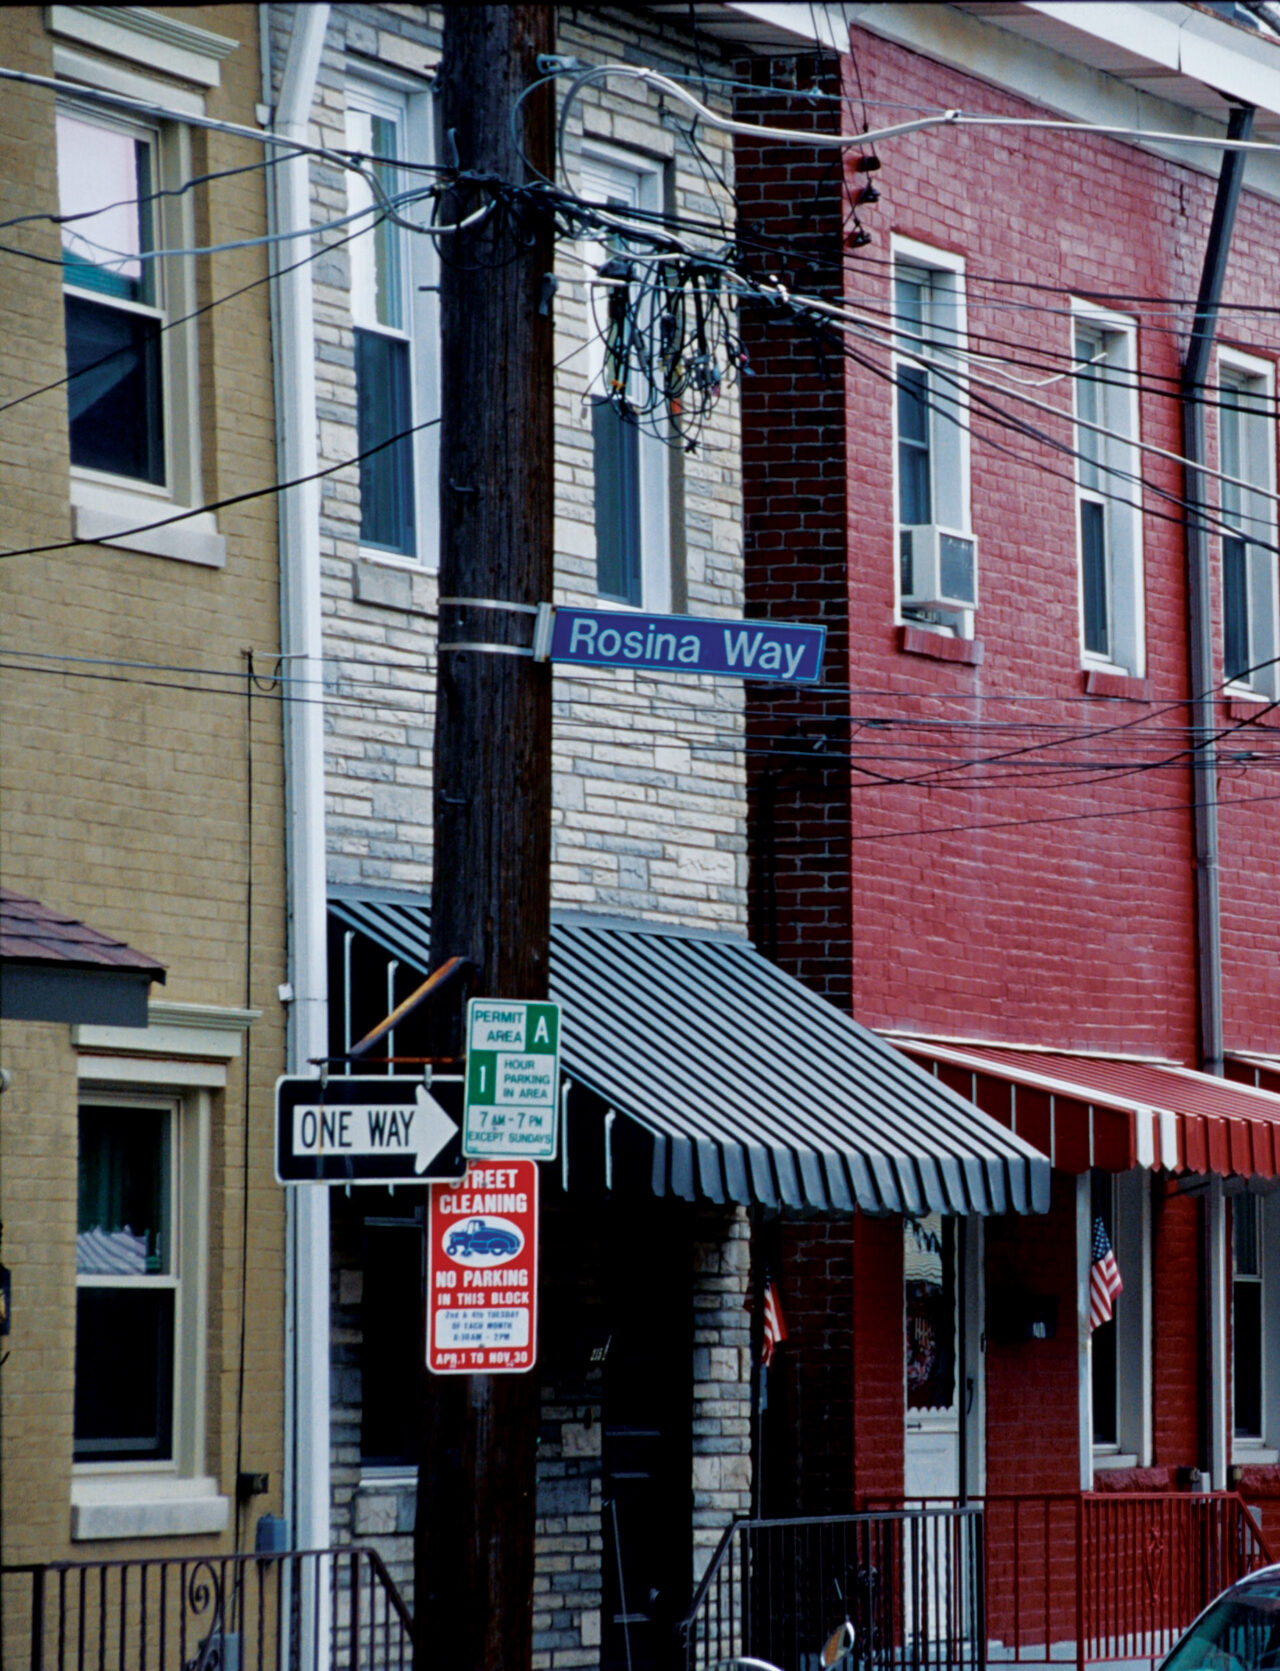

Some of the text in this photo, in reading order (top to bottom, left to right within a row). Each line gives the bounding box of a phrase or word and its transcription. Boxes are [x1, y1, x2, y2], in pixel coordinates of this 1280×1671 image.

[570, 617, 806, 678] Rosina Way
[475, 1010, 524, 1024] PERMIT
[533, 1015, 550, 1043] A
[486, 1030, 523, 1043] AREA
[504, 1059, 535, 1070] HOUR
[480, 1065, 486, 1093] 1
[504, 1073, 550, 1084] PARKING
[503, 1087, 548, 1098] IN AREA
[480, 1111, 488, 1128] 7
[492, 1114, 505, 1126] AM
[517, 1112, 526, 1129] 7
[529, 1115, 542, 1127] PM
[301, 1109, 415, 1148] ONE WAY
[468, 1131, 552, 1144] EXCEPT SUNDAYS
[439, 1193, 528, 1214] CLEANING
[436, 1269, 529, 1288] NO PARKING
[437, 1291, 529, 1306] IN THIS BLOCK
[487, 1310, 519, 1318] TUESDAY
[470, 1352, 484, 1364] TO
